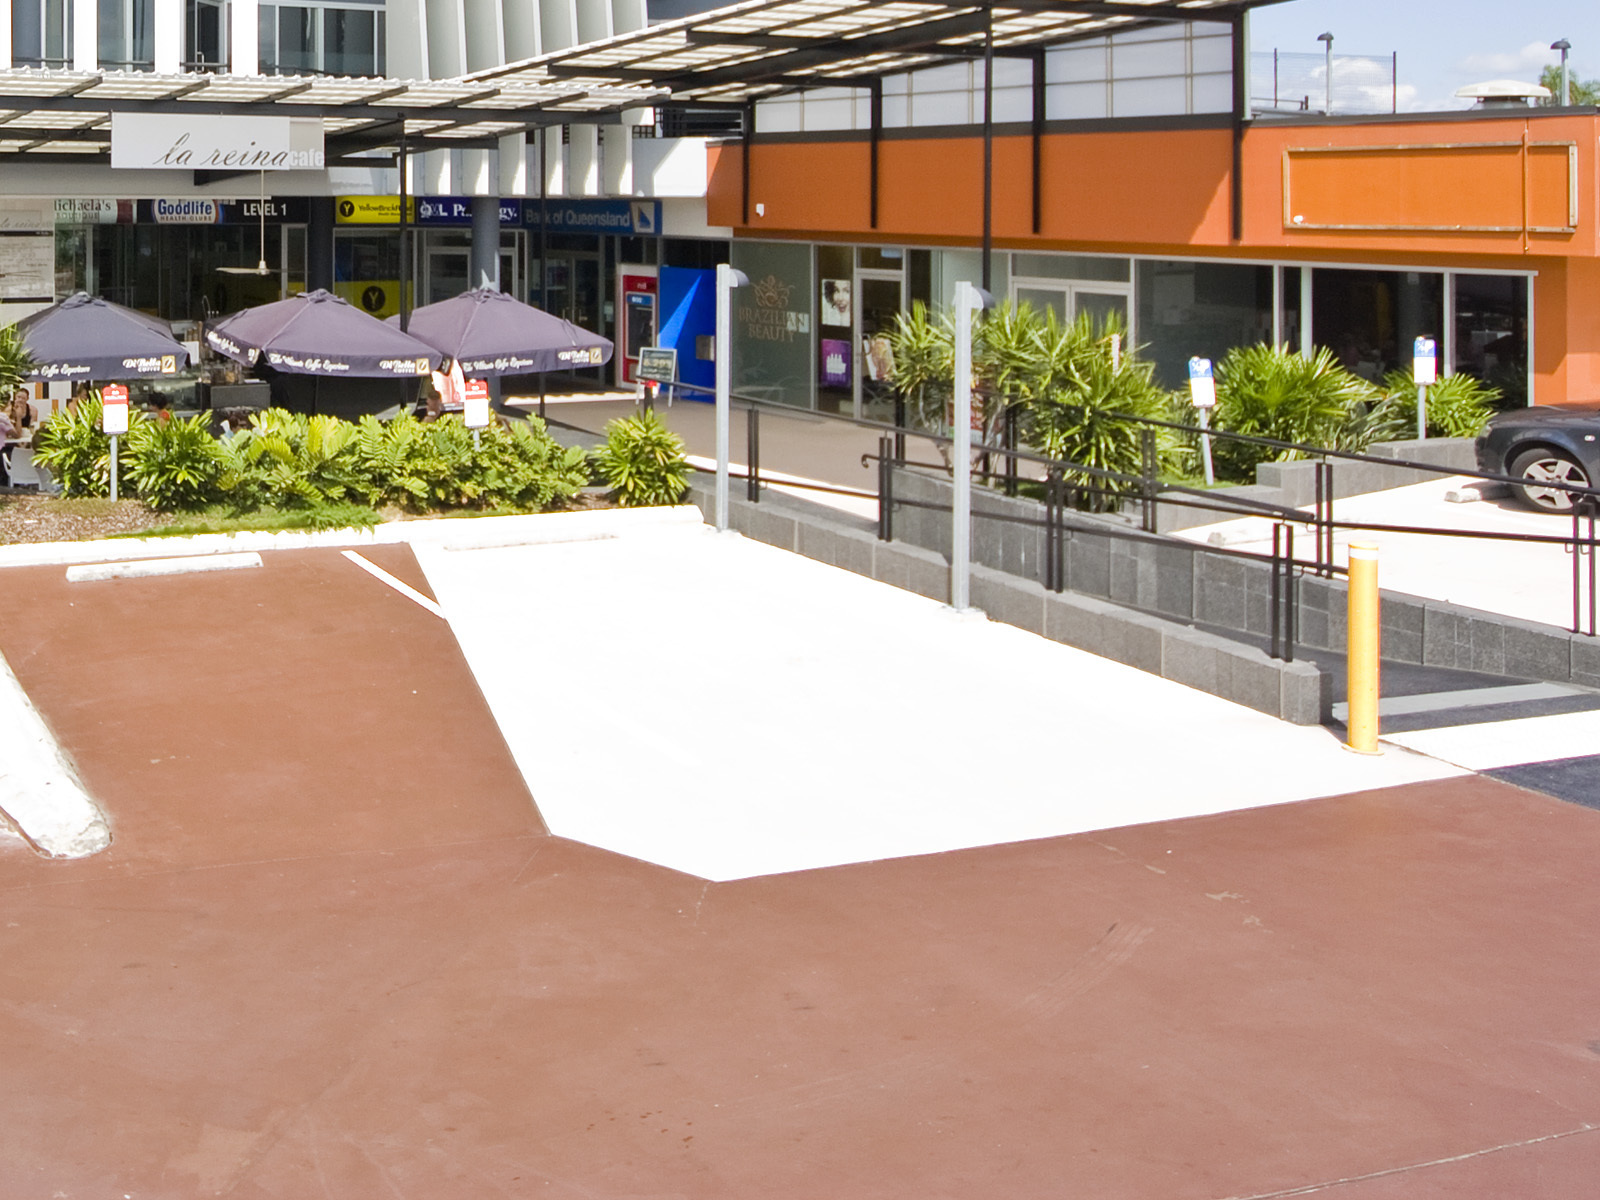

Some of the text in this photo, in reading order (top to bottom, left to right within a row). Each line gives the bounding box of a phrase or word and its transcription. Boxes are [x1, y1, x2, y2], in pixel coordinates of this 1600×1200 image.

[152, 132, 325, 167] la reina cafe
[54, 199, 111, 211] ichaela's
[158, 198, 212, 215] Goodlife
[243, 203, 287, 216] LEVEL 1
[526, 209, 551, 224] Bak
[567, 210, 630, 227] Queensland
[748, 323, 795, 342] BEAUTY
